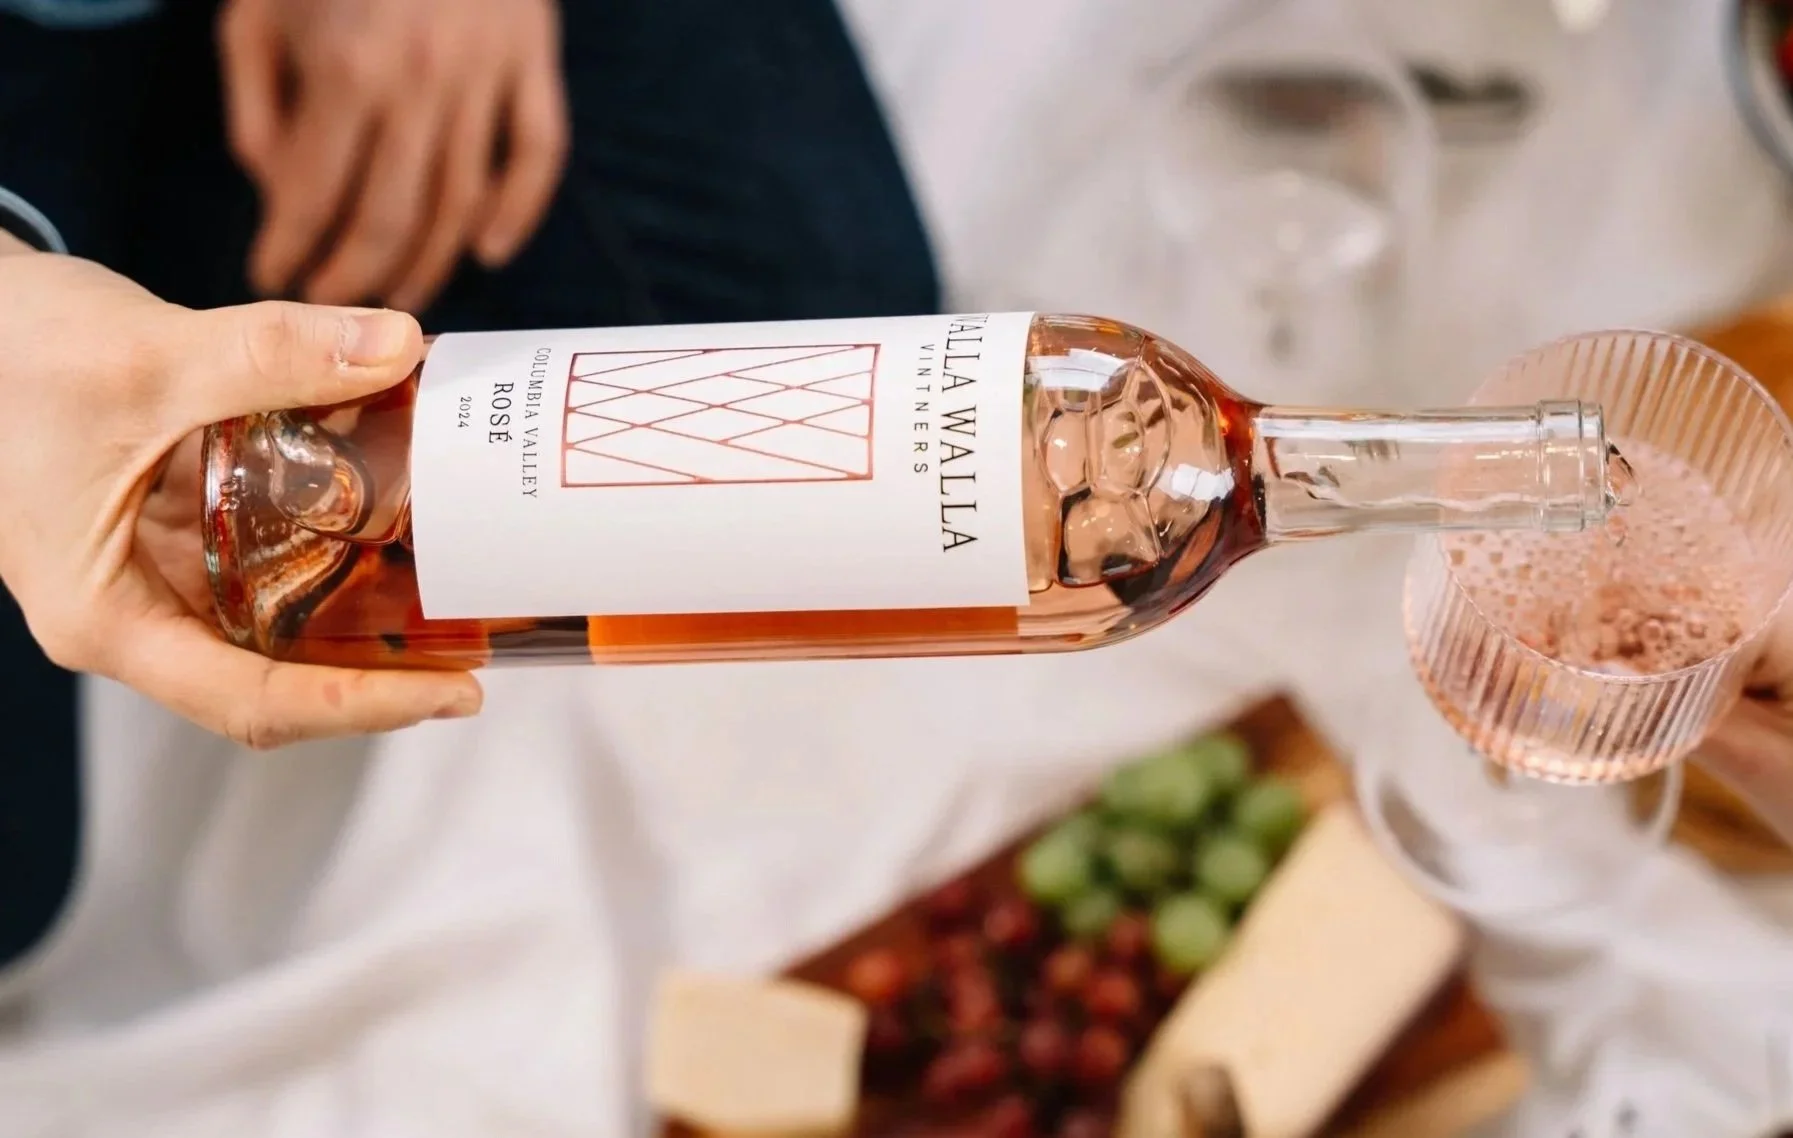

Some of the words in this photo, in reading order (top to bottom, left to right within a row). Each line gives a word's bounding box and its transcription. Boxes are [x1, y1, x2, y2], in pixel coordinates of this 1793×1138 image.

[458, 396, 472, 428] 2024
[488, 382, 515, 443] ROSÉ
[525, 347, 552, 419] COLUMBIA
[914, 344, 935, 473] VINTNERS
[522, 427, 539, 498] VALLEY
[940, 404, 978, 552] WALLA
